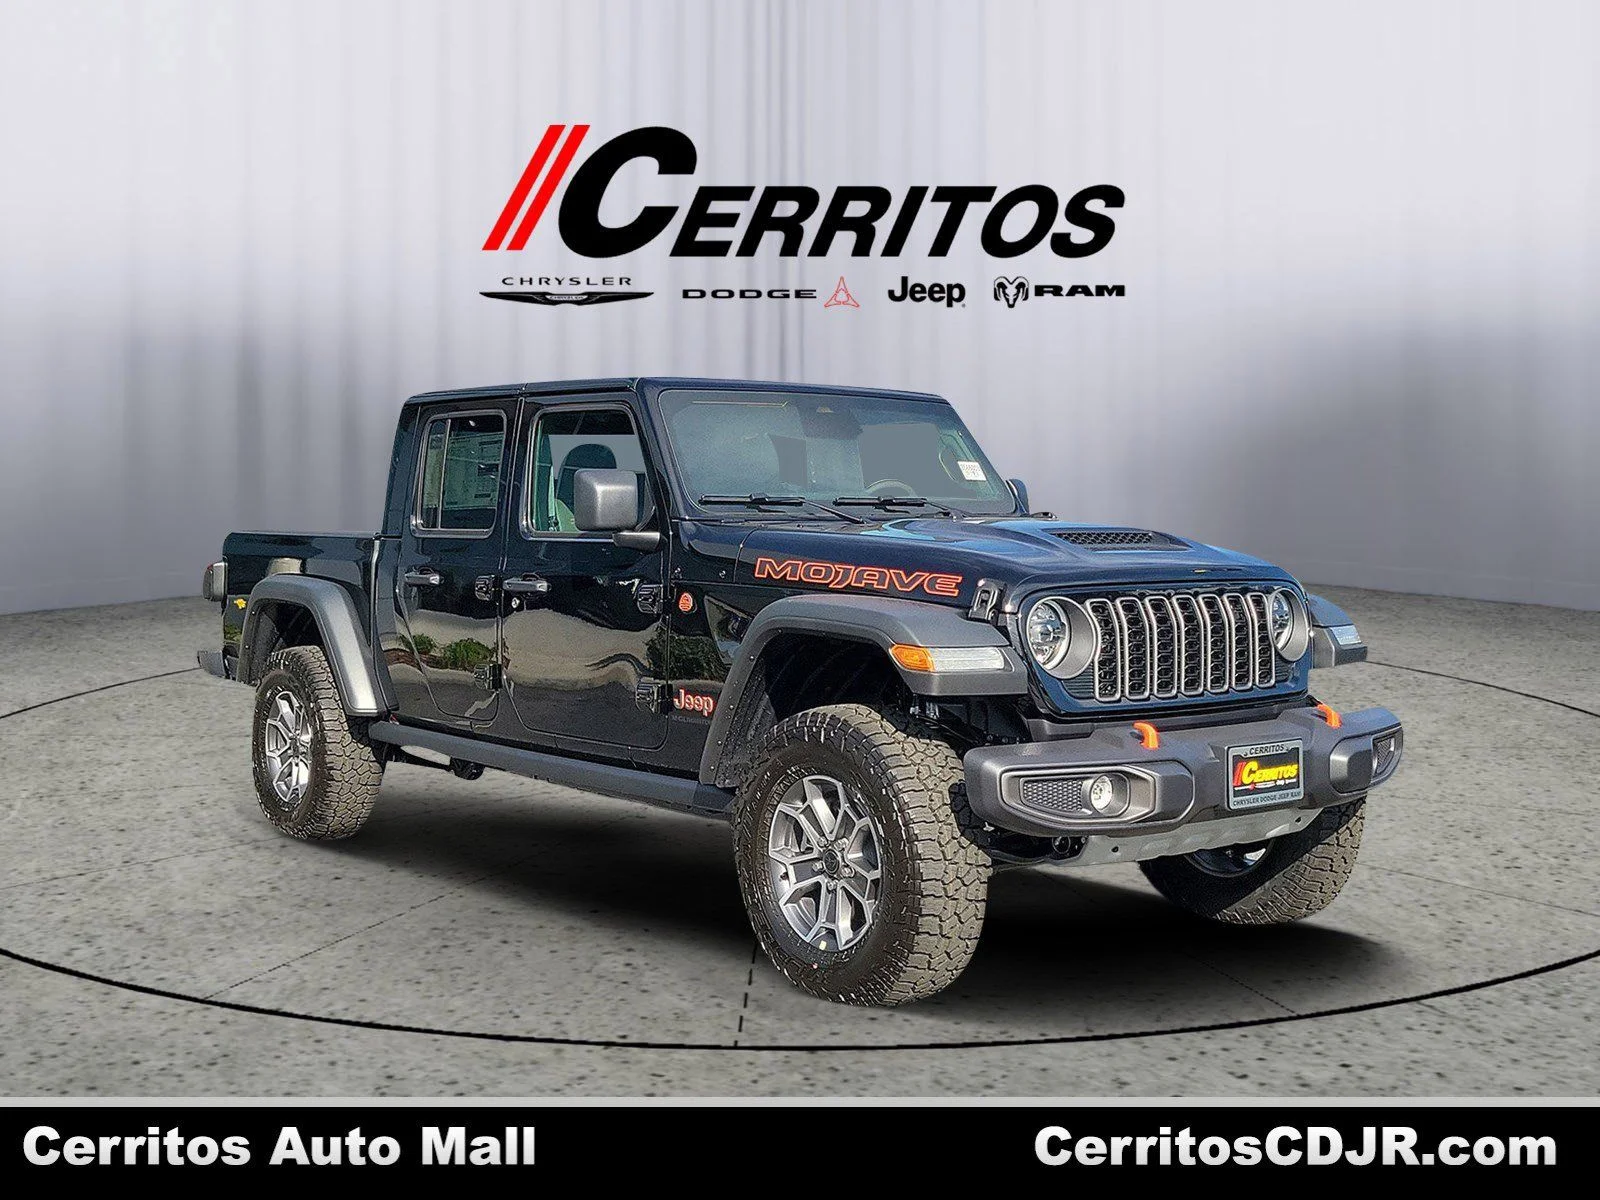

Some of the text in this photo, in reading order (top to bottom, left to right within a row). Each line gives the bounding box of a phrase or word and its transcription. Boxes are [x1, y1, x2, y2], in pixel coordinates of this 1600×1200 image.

[754, 556, 963, 597] MOJAVE
[673, 688, 714, 717] Jeep
[1249, 744, 1285, 755] CERRITOS
